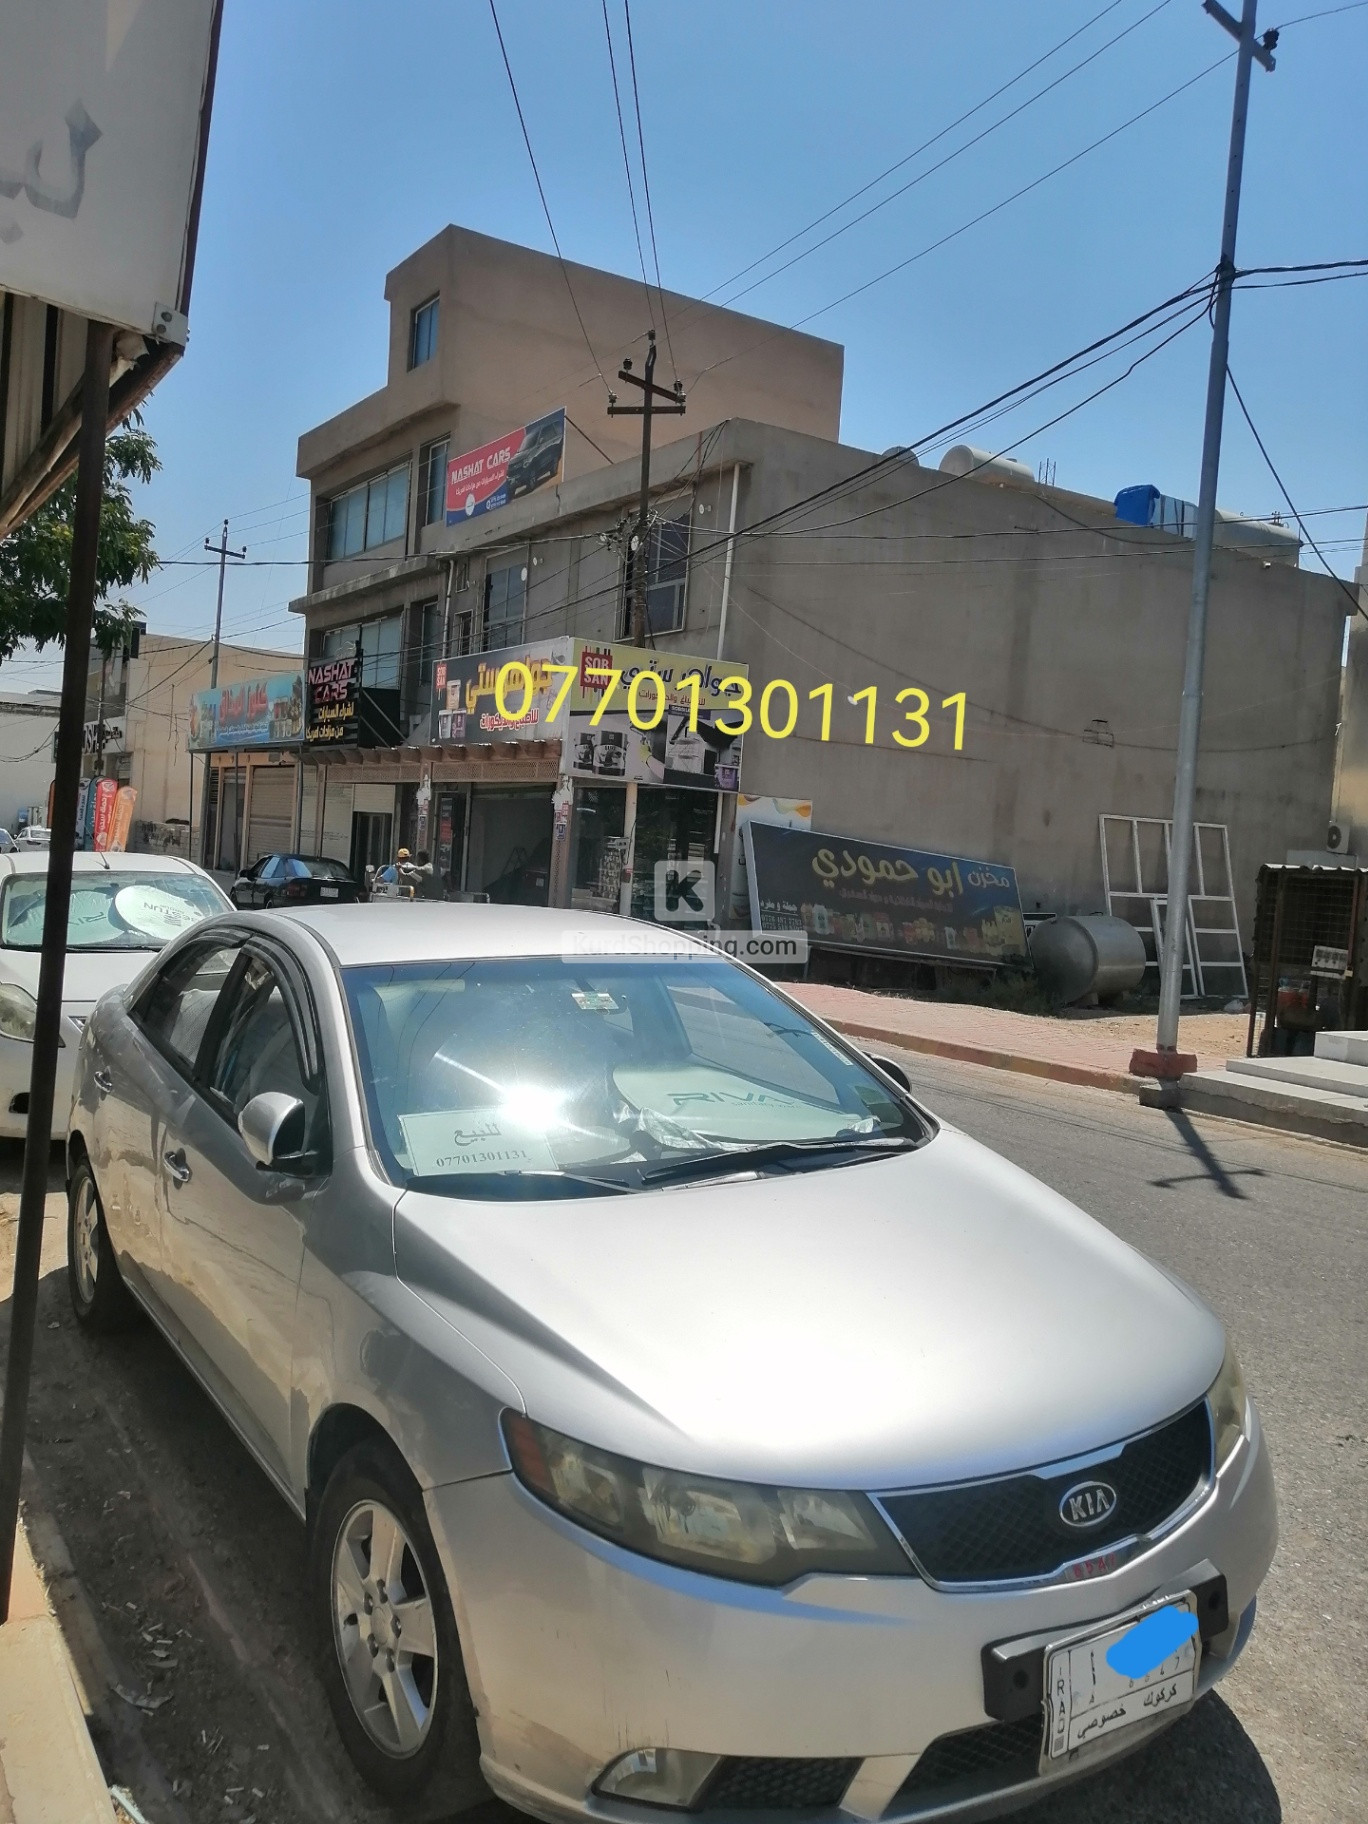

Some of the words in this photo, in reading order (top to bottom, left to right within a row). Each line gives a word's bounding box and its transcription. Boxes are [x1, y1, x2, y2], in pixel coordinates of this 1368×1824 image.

[451, 459, 484, 485] NASHAT
[486, 447, 512, 469] CARS
[308, 661, 355, 685] NASHAT
[585, 656, 610, 671] SOB
[314, 684, 348, 703] CARS
[811, 848, 919, 890] حمودي
[927, 860, 965, 898] ابو
[966, 864, 1010, 890] مخزن
[454, 1121, 502, 1147] للبيع
[436, 1149, 528, 1168] 07701301131
[1068, 1488, 1111, 1522] KIA
[1143, 1683, 1178, 1708] كركوك
[1077, 1704, 1128, 1740] خصوصي
